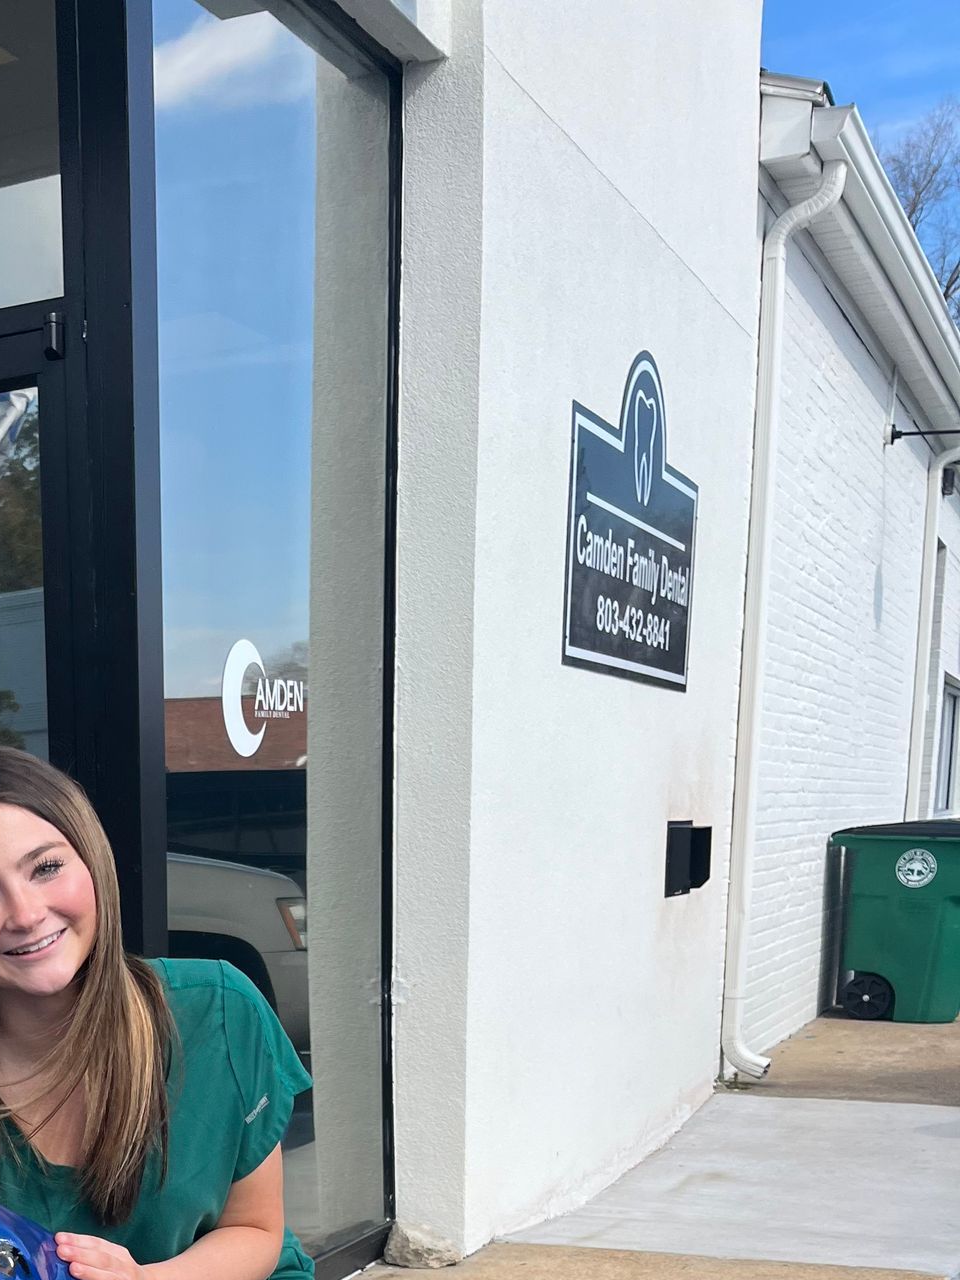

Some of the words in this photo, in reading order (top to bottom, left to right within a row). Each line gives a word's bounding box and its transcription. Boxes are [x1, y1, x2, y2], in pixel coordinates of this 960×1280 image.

[577, 514, 624, 580] Camden
[626, 536, 659, 605] Family
[660, 555, 690, 607] Dental
[596, 594, 671, 651] 803-432-8841
